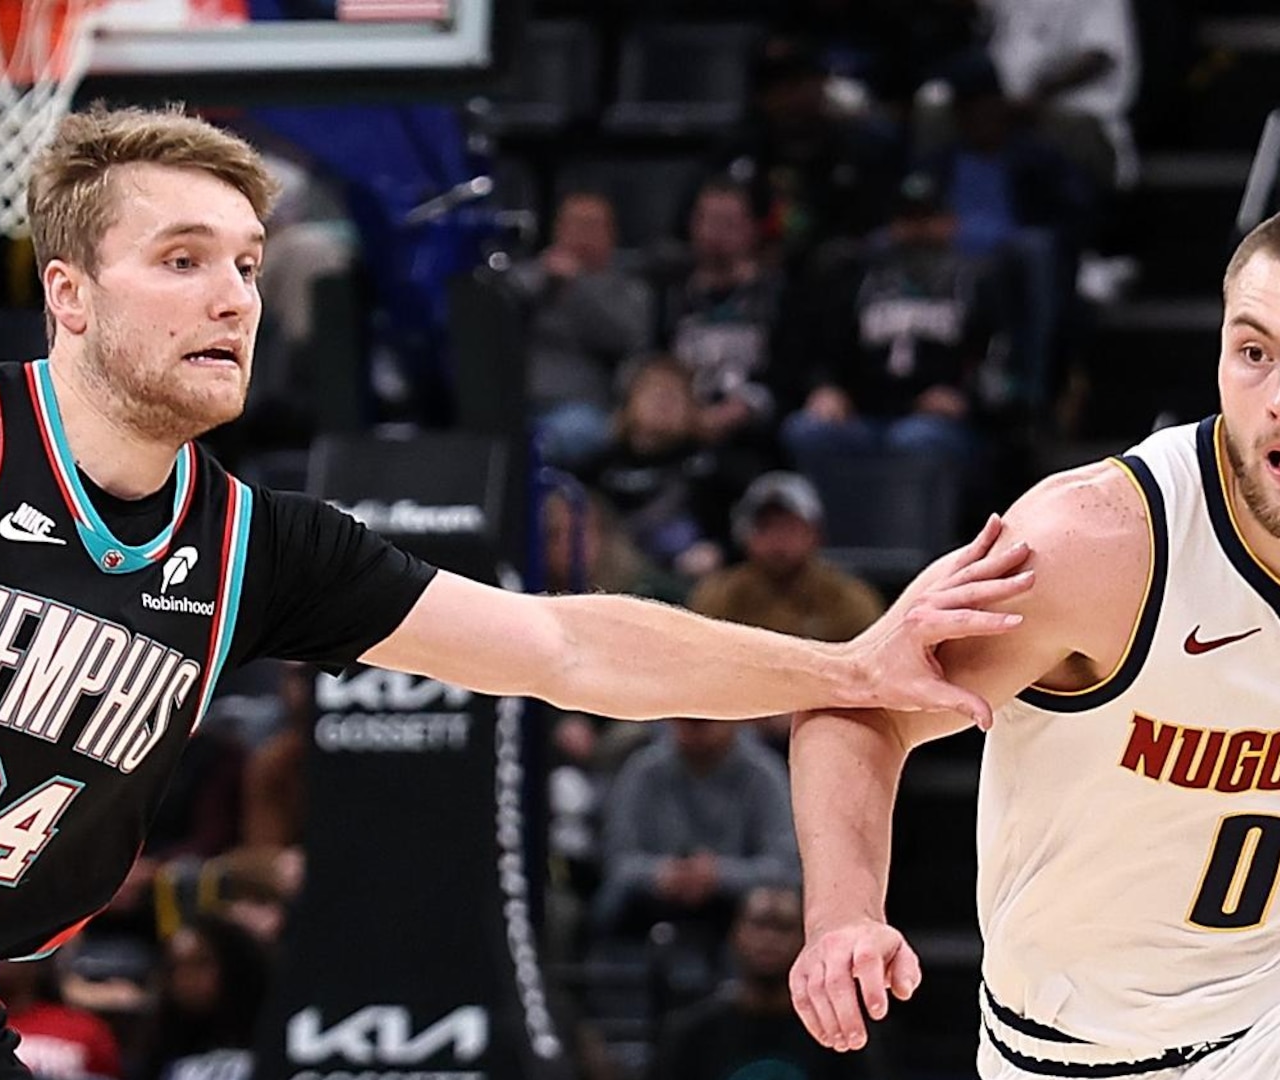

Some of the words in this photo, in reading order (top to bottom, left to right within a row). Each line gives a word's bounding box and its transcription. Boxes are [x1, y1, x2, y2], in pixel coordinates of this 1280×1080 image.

[11, 502, 56, 535] NIKE
[141, 592, 215, 616] Robinhood
[286, 1004, 488, 1064] KIA
